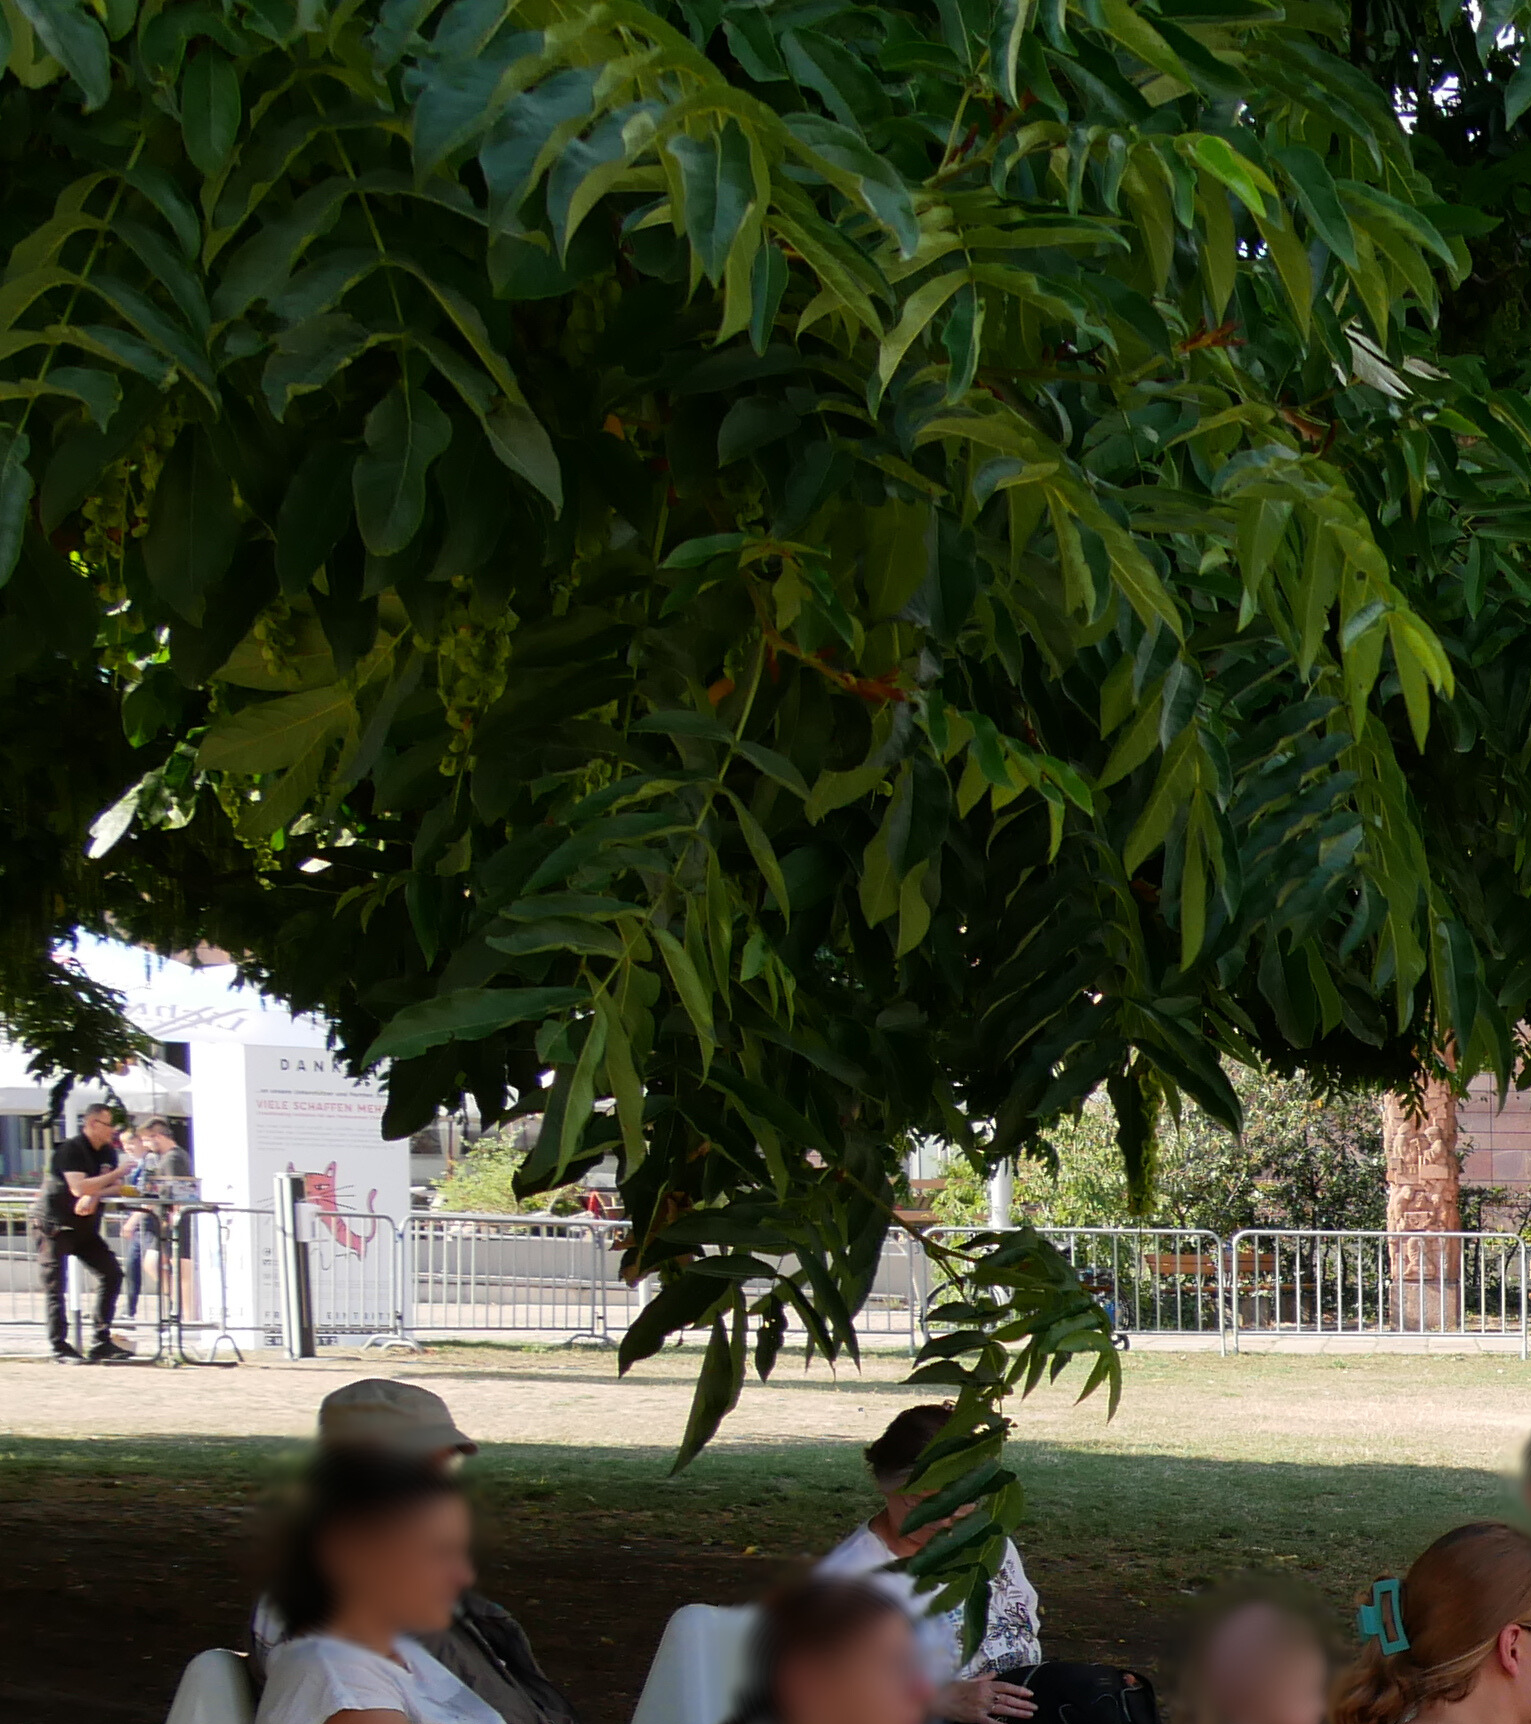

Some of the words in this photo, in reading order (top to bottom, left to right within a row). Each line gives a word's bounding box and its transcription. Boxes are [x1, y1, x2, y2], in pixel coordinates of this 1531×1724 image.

[280, 1057, 342, 1073] DANK
[256, 1100, 288, 1110] VIELE
[293, 1101, 352, 1112] SCHAFFEN
